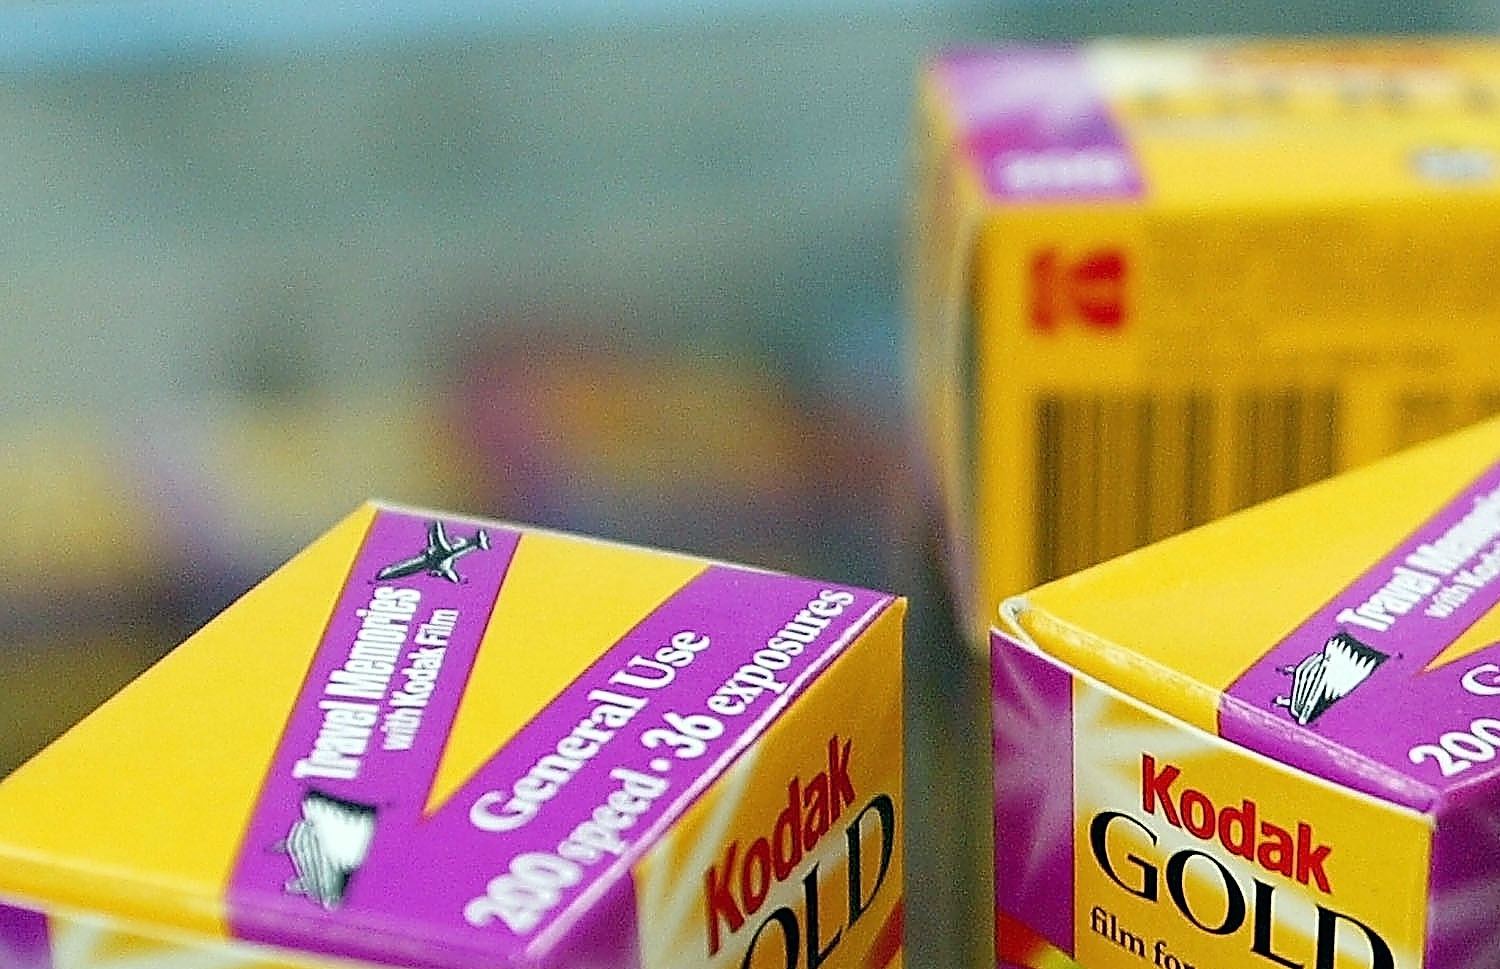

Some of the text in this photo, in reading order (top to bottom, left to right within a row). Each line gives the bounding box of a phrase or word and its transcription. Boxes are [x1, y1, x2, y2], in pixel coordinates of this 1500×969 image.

[292, 586, 421, 779] Travel Memories
[379, 608, 460, 751] with Kodak Film
[1336, 565, 1441, 633] Travel
[463, 588, 855, 935] 200 speed 36 exposures
[468, 628, 712, 833] General Use
[703, 733, 859, 958] Kodak
[1140, 753, 1333, 895] Kodak
[1089, 905, 1146, 960] film
